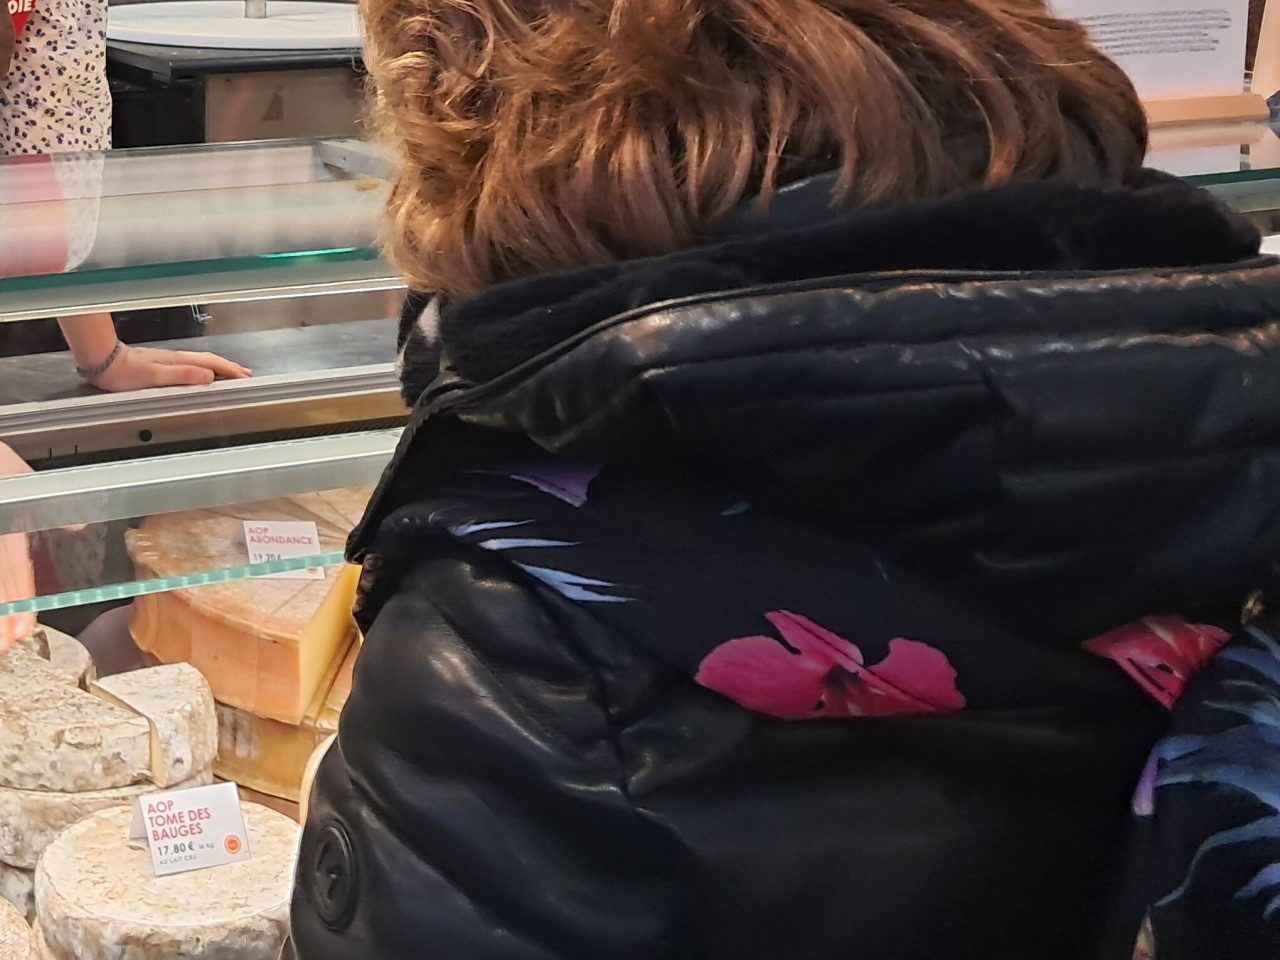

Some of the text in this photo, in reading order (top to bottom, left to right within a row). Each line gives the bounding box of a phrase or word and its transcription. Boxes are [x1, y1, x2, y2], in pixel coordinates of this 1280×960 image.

[249, 535, 313, 545] ABONDANCE
[148, 800, 174, 814] AOP
[148, 807, 211, 828] TOME DES
[152, 822, 203, 841] BAUGES
[157, 843, 186, 856] 17.80
